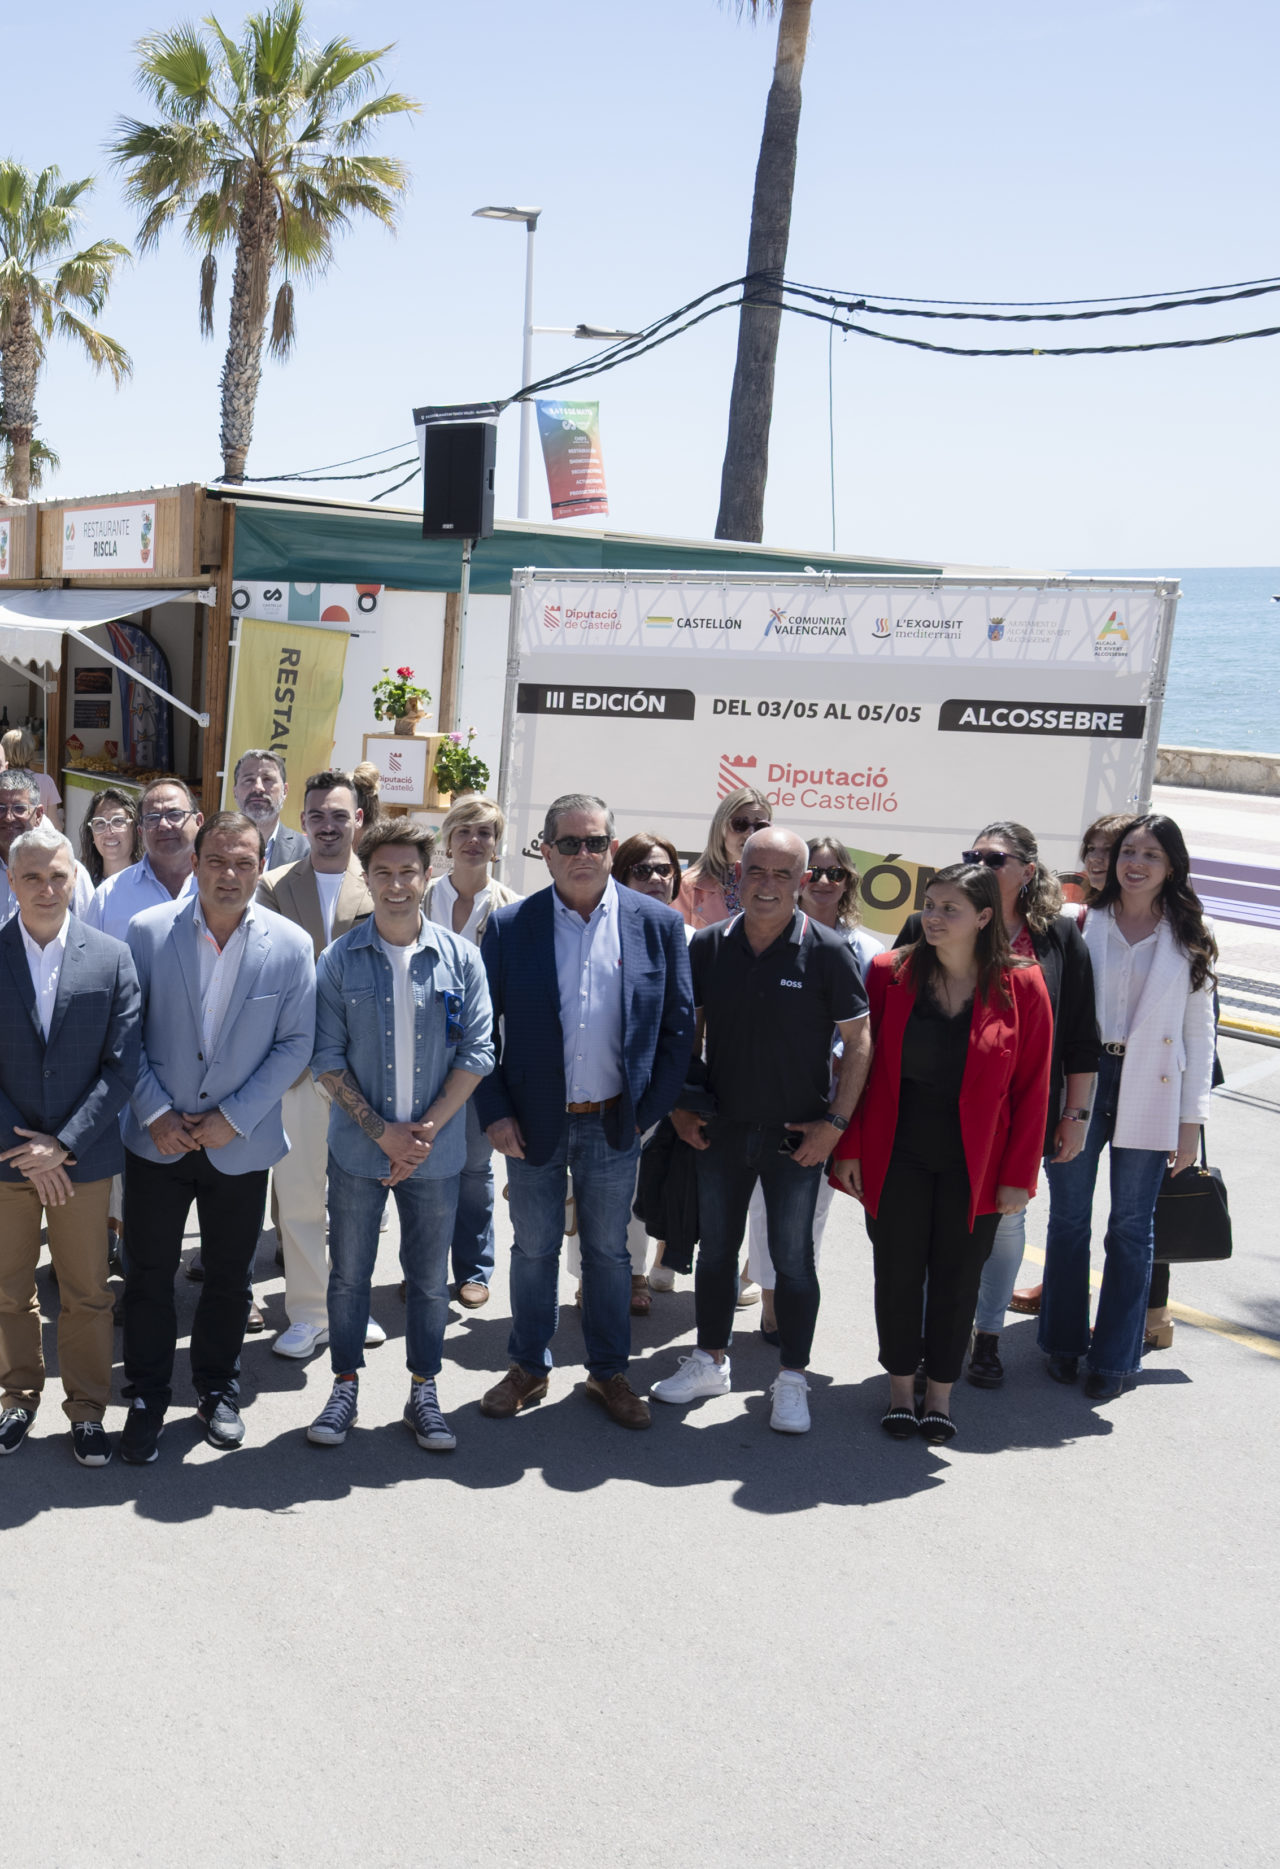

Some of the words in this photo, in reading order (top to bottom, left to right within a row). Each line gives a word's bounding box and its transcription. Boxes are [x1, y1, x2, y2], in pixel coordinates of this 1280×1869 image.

[83, 518, 130, 538] RESTAURANTE
[93, 540, 118, 557] RISCLA
[565, 608, 618, 621] Diputació
[788, 616, 848, 626] COMUNITAT
[564, 620, 578, 629] de
[579, 620, 622, 630] Castelló
[676, 616, 742, 630] CASTELLÓN
[895, 618, 964, 630] L'EXQUISIT
[775, 625, 847, 637] VALENCIANA
[895, 629, 962, 640] mediterrani
[545, 690, 565, 709] III
[571, 690, 666, 713] EDICIÓN
[712, 698, 751, 716] DEL
[757, 699, 818, 720] 03/05
[823, 703, 851, 721] AL
[857, 704, 922, 724] 05/05
[958, 707, 1124, 731] ALCOSSEBRE
[767, 763, 889, 788] Diputació
[766, 787, 796, 807] de
[800, 789, 898, 812] Castelló
[780, 978, 803, 989] BOSS
